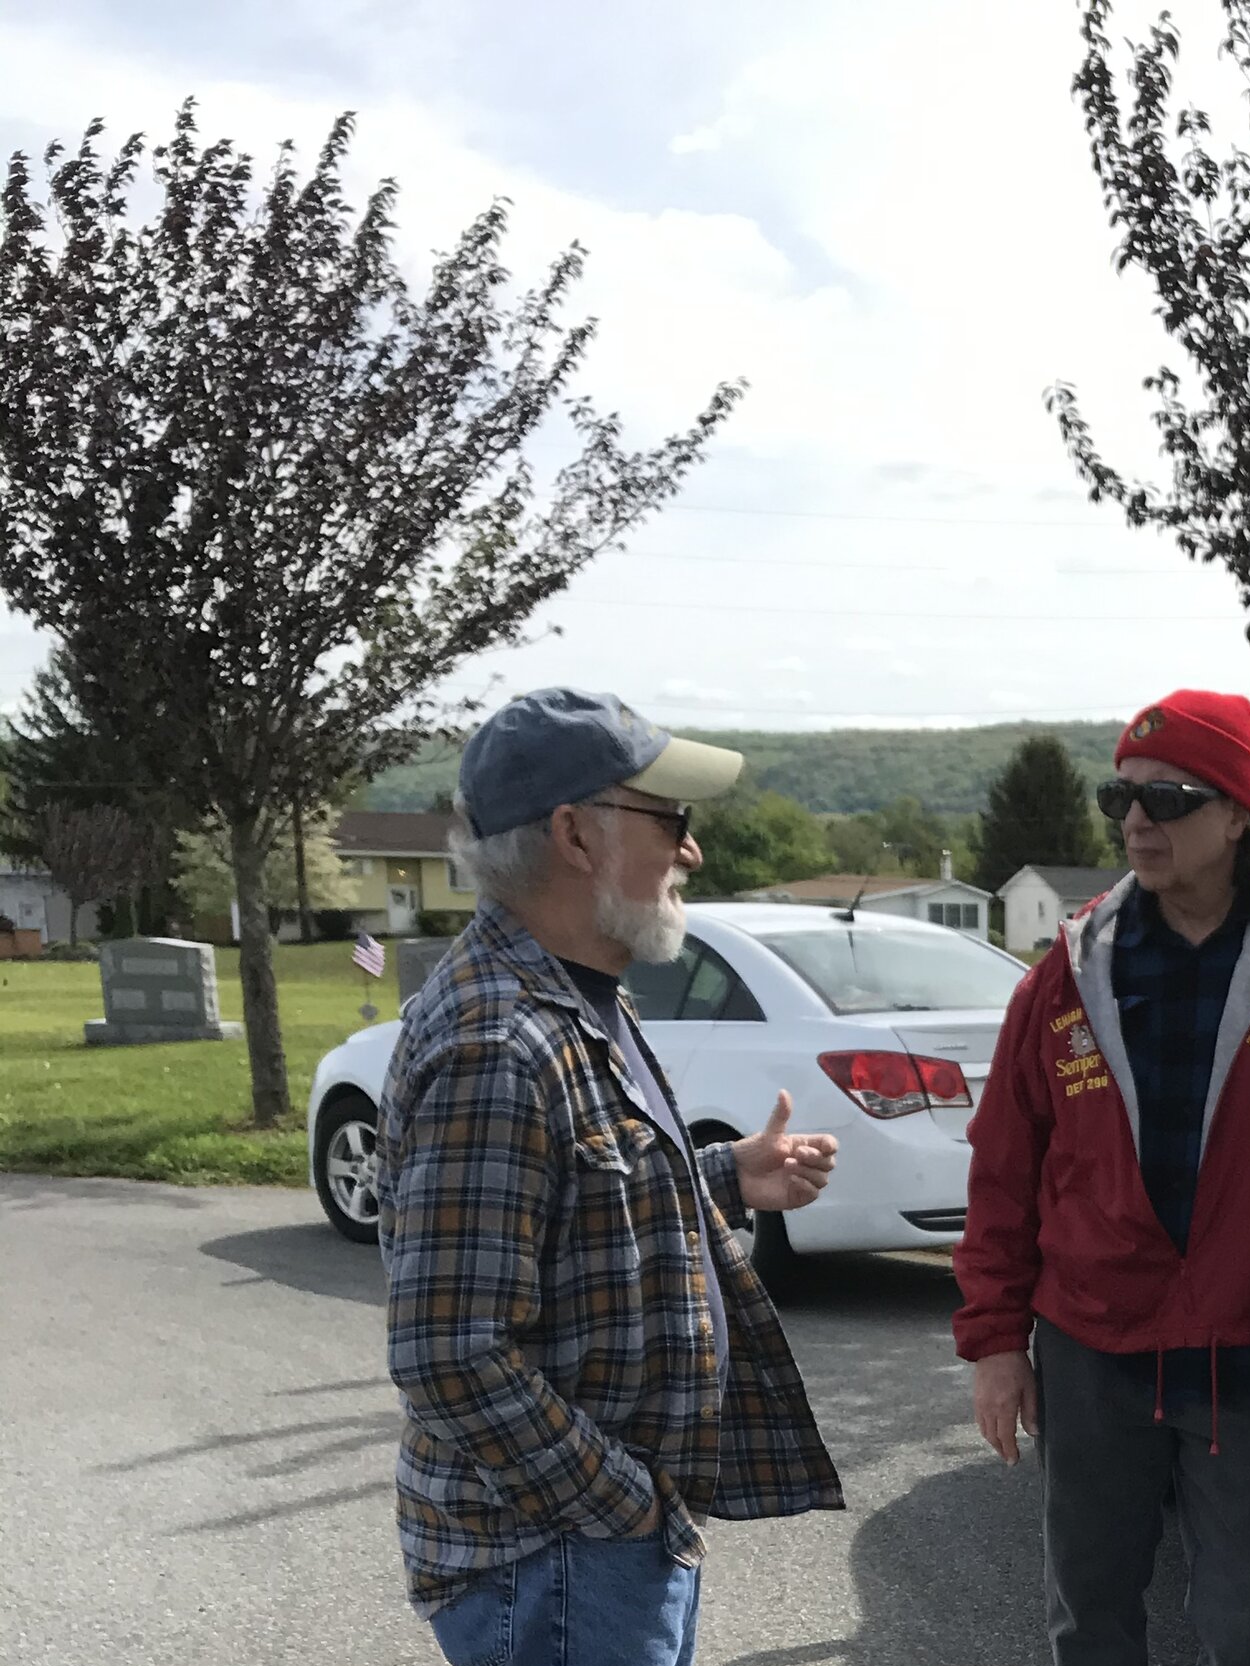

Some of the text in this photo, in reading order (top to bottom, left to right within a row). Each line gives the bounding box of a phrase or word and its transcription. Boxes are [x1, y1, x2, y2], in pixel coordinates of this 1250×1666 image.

[1049, 1007, 1083, 1033] LEHIGH
[1056, 1053, 1101, 1079] Semper
[1066, 1081, 1084, 1097] DET
